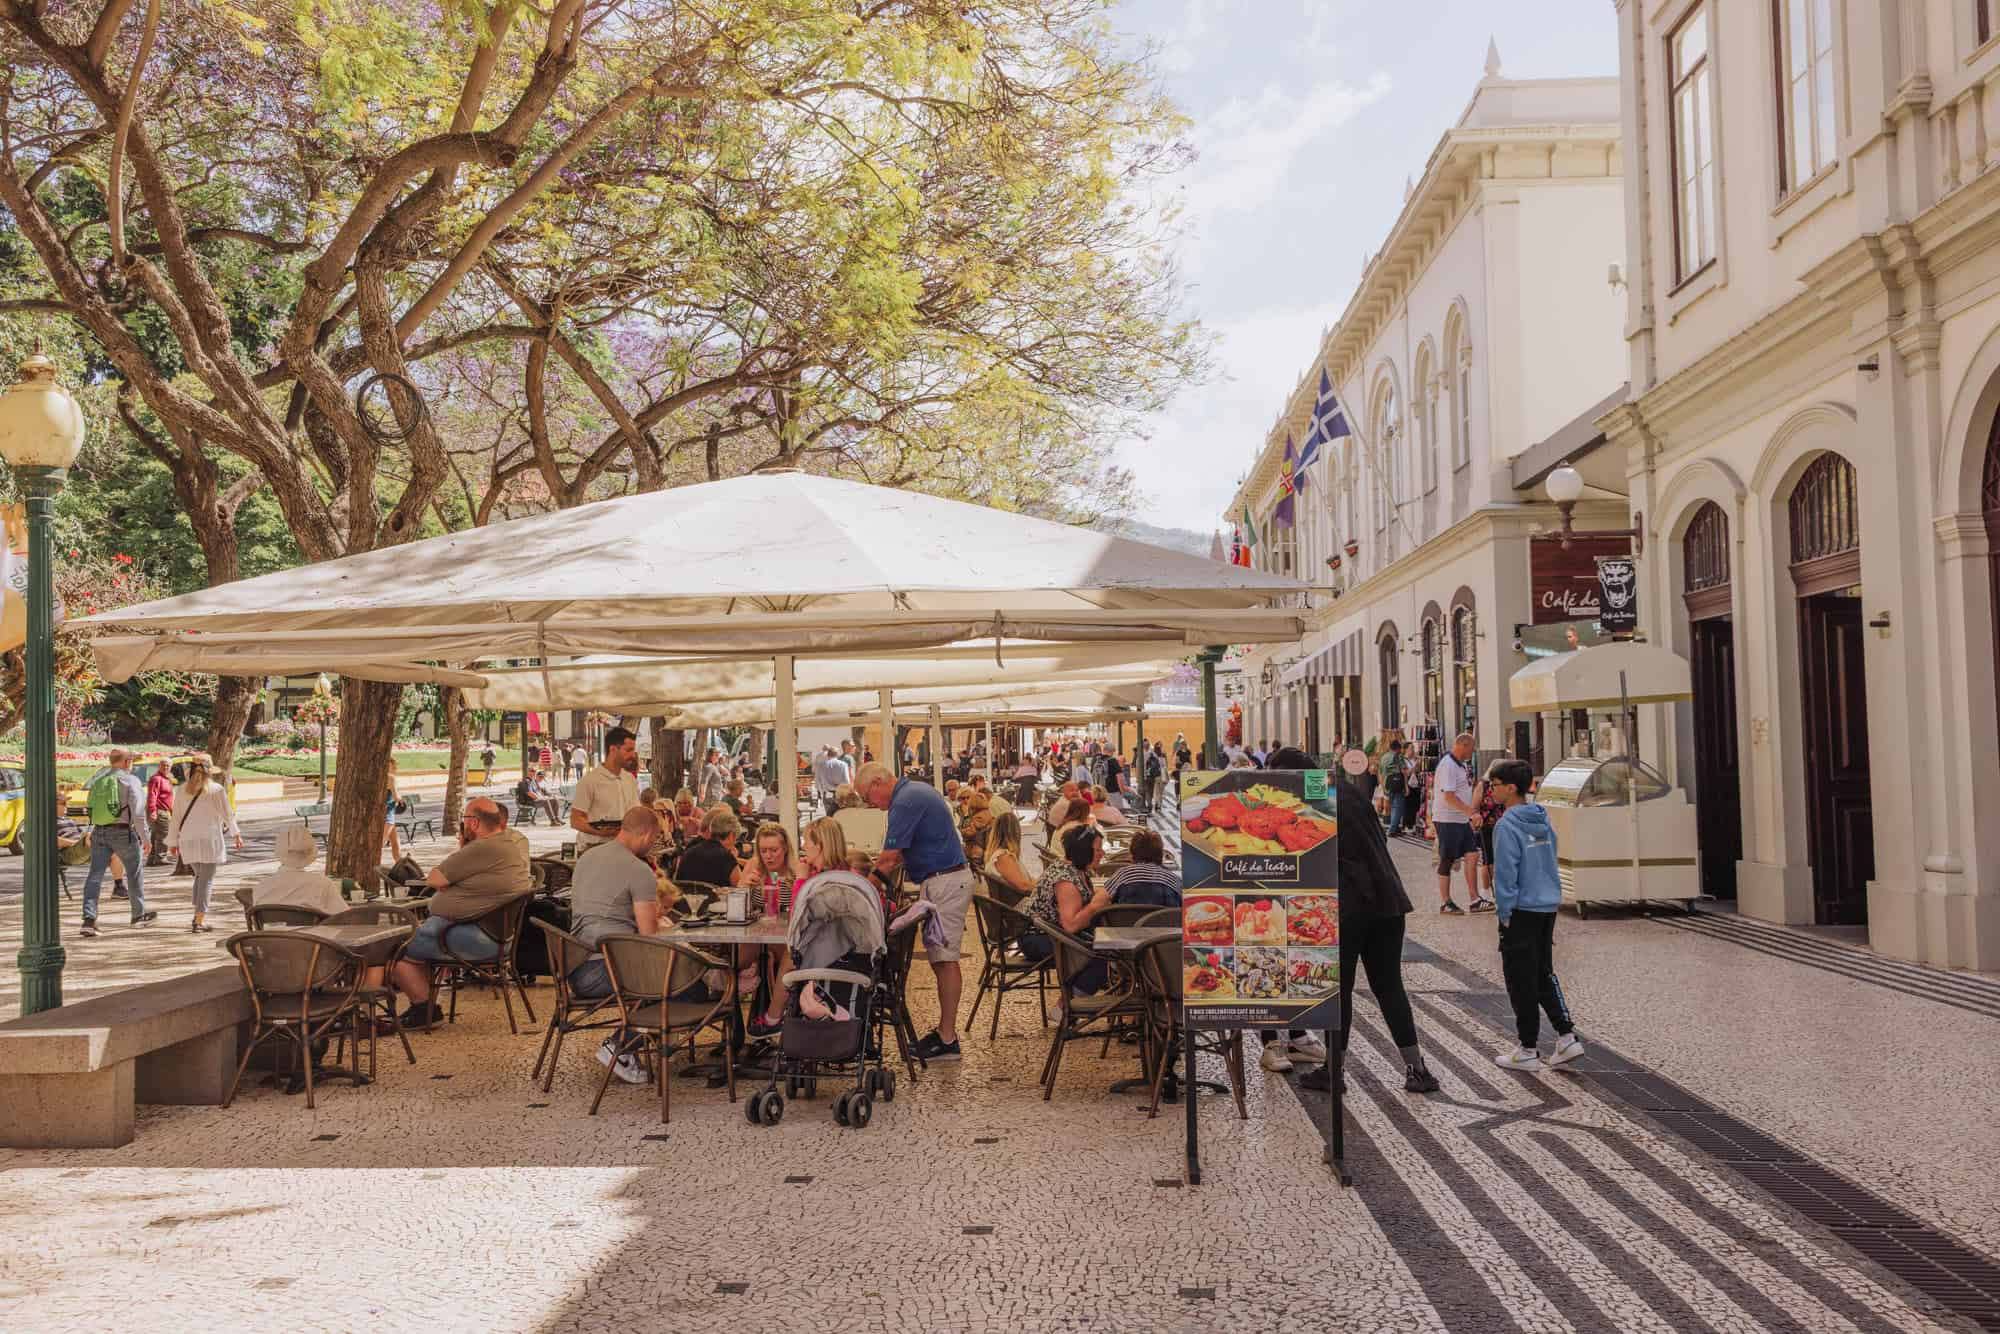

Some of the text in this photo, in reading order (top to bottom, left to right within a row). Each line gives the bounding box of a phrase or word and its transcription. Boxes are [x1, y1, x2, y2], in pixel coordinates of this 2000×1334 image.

[1542, 589, 1600, 613] Café do
[1225, 859, 1296, 876] Café do Teatro
